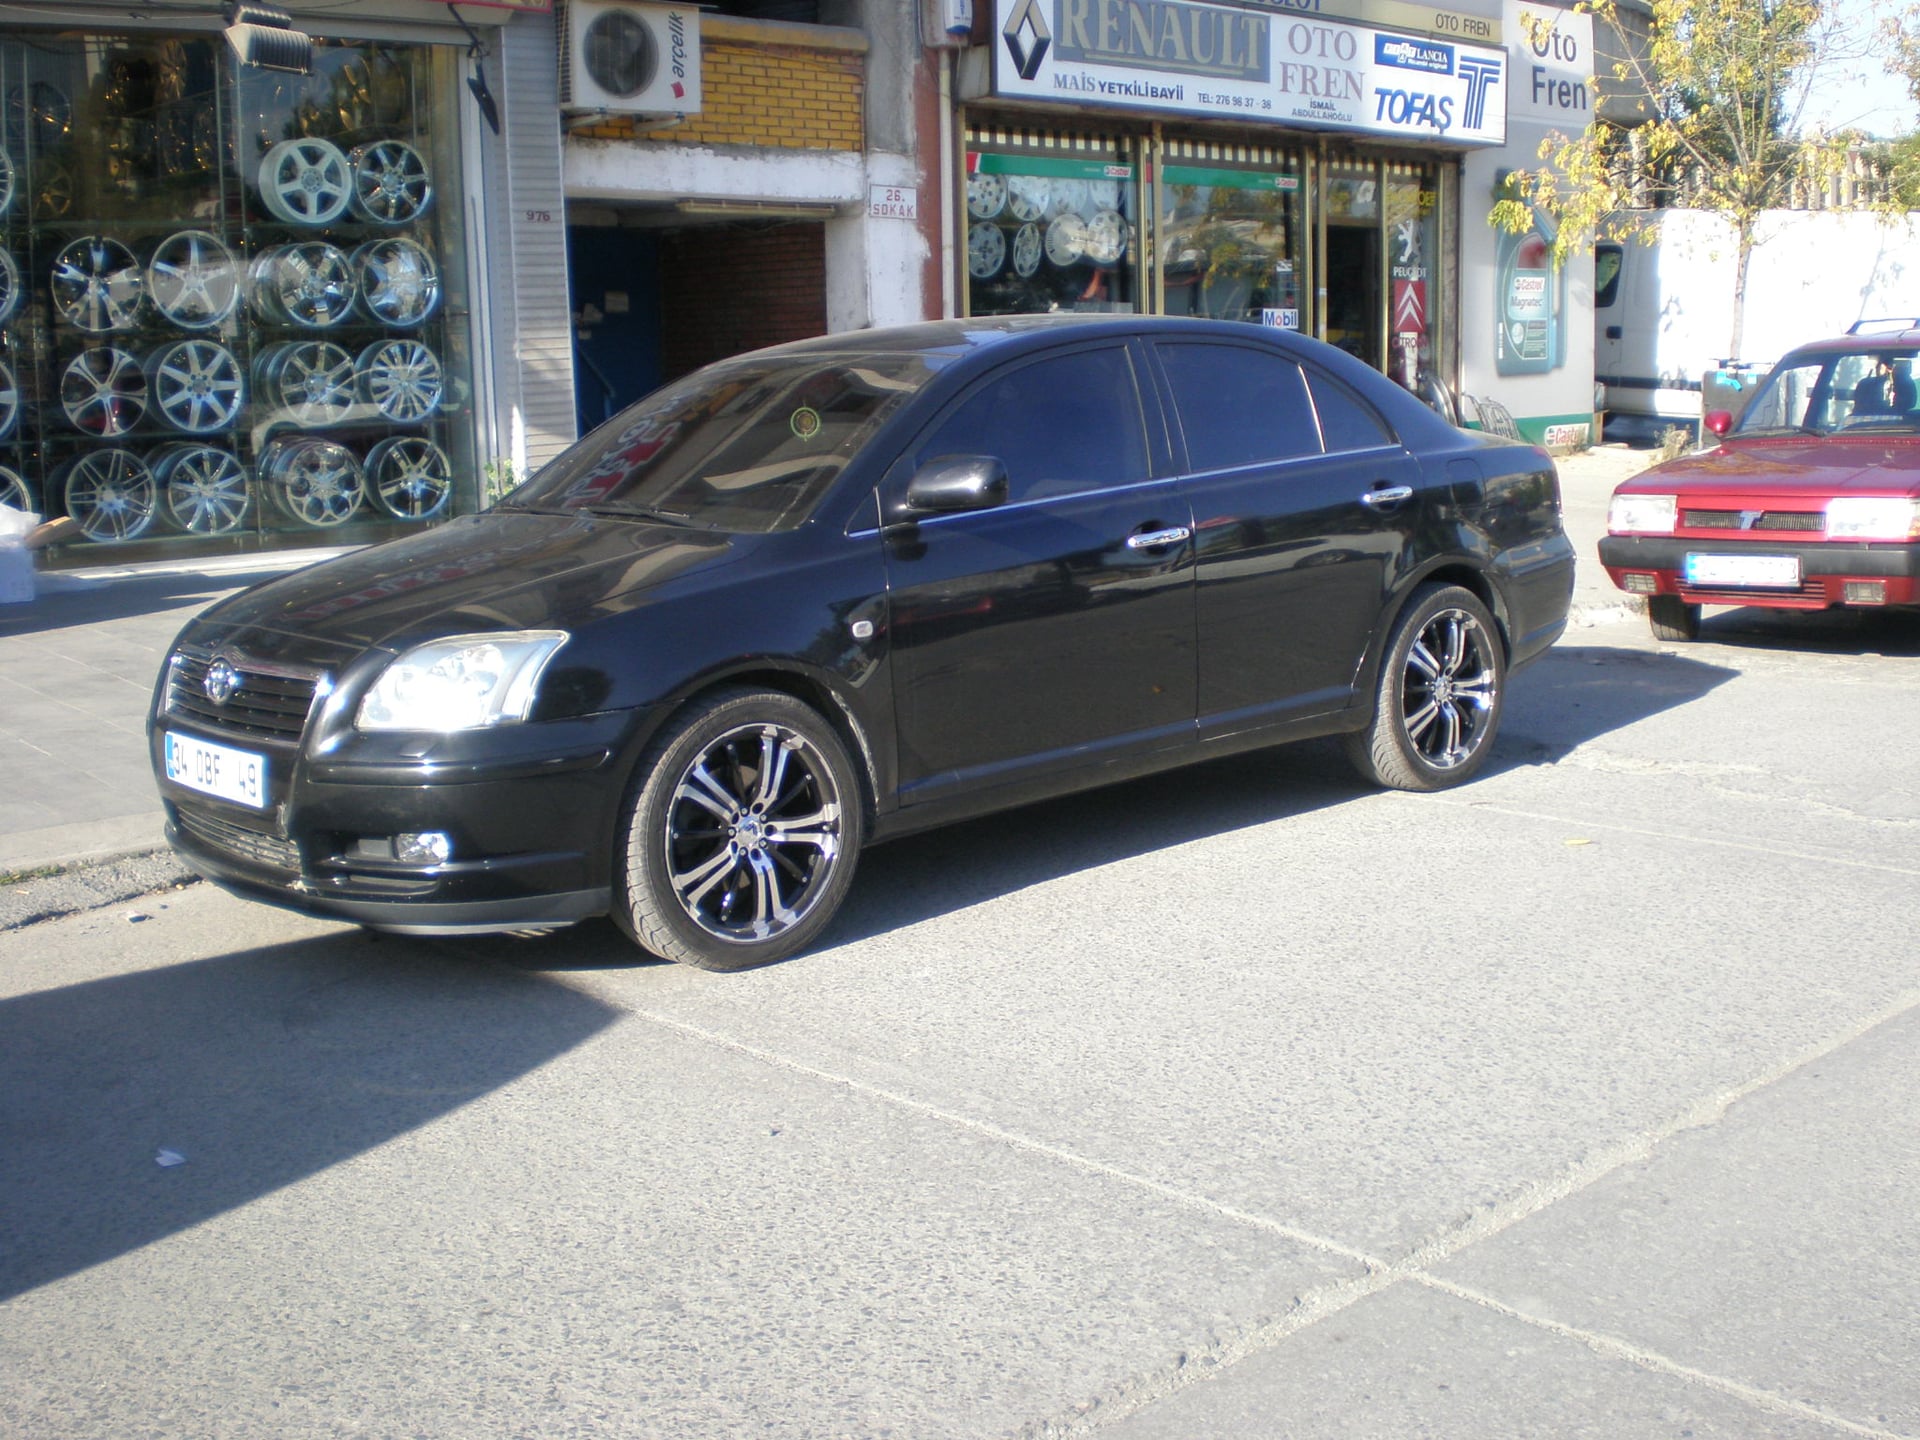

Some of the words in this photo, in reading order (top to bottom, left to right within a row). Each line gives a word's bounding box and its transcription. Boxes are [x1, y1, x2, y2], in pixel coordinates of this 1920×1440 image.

[1059, 0, 1266, 69] RENAULT
[1435, 13, 1459, 31] OTO
[1463, 18, 1491, 37] FREN
[1530, 18, 1577, 63] Oto
[668, 11, 687, 79] arçelik
[1287, 23, 1357, 62] OTO
[1417, 48, 1448, 64] LANCIA
[1279, 61, 1366, 102] FREN
[1531, 65, 1587, 110] Fren
[1198, 92, 1214, 104] TEL:
[1215, 94, 1231, 106] 276
[1244, 97, 1255, 108] 37
[1261, 98, 1272, 110] 38
[1374, 87, 1454, 134] TOFAŞ
[873, 203, 914, 217] SOKAK
[886, 189, 905, 201] 26.
[526, 210, 551, 221] 976
[1264, 311, 1297, 327] Mobil
[1555, 424, 1587, 445] Castr
[173, 742, 187, 776] 34
[239, 760, 256, 798] 49
